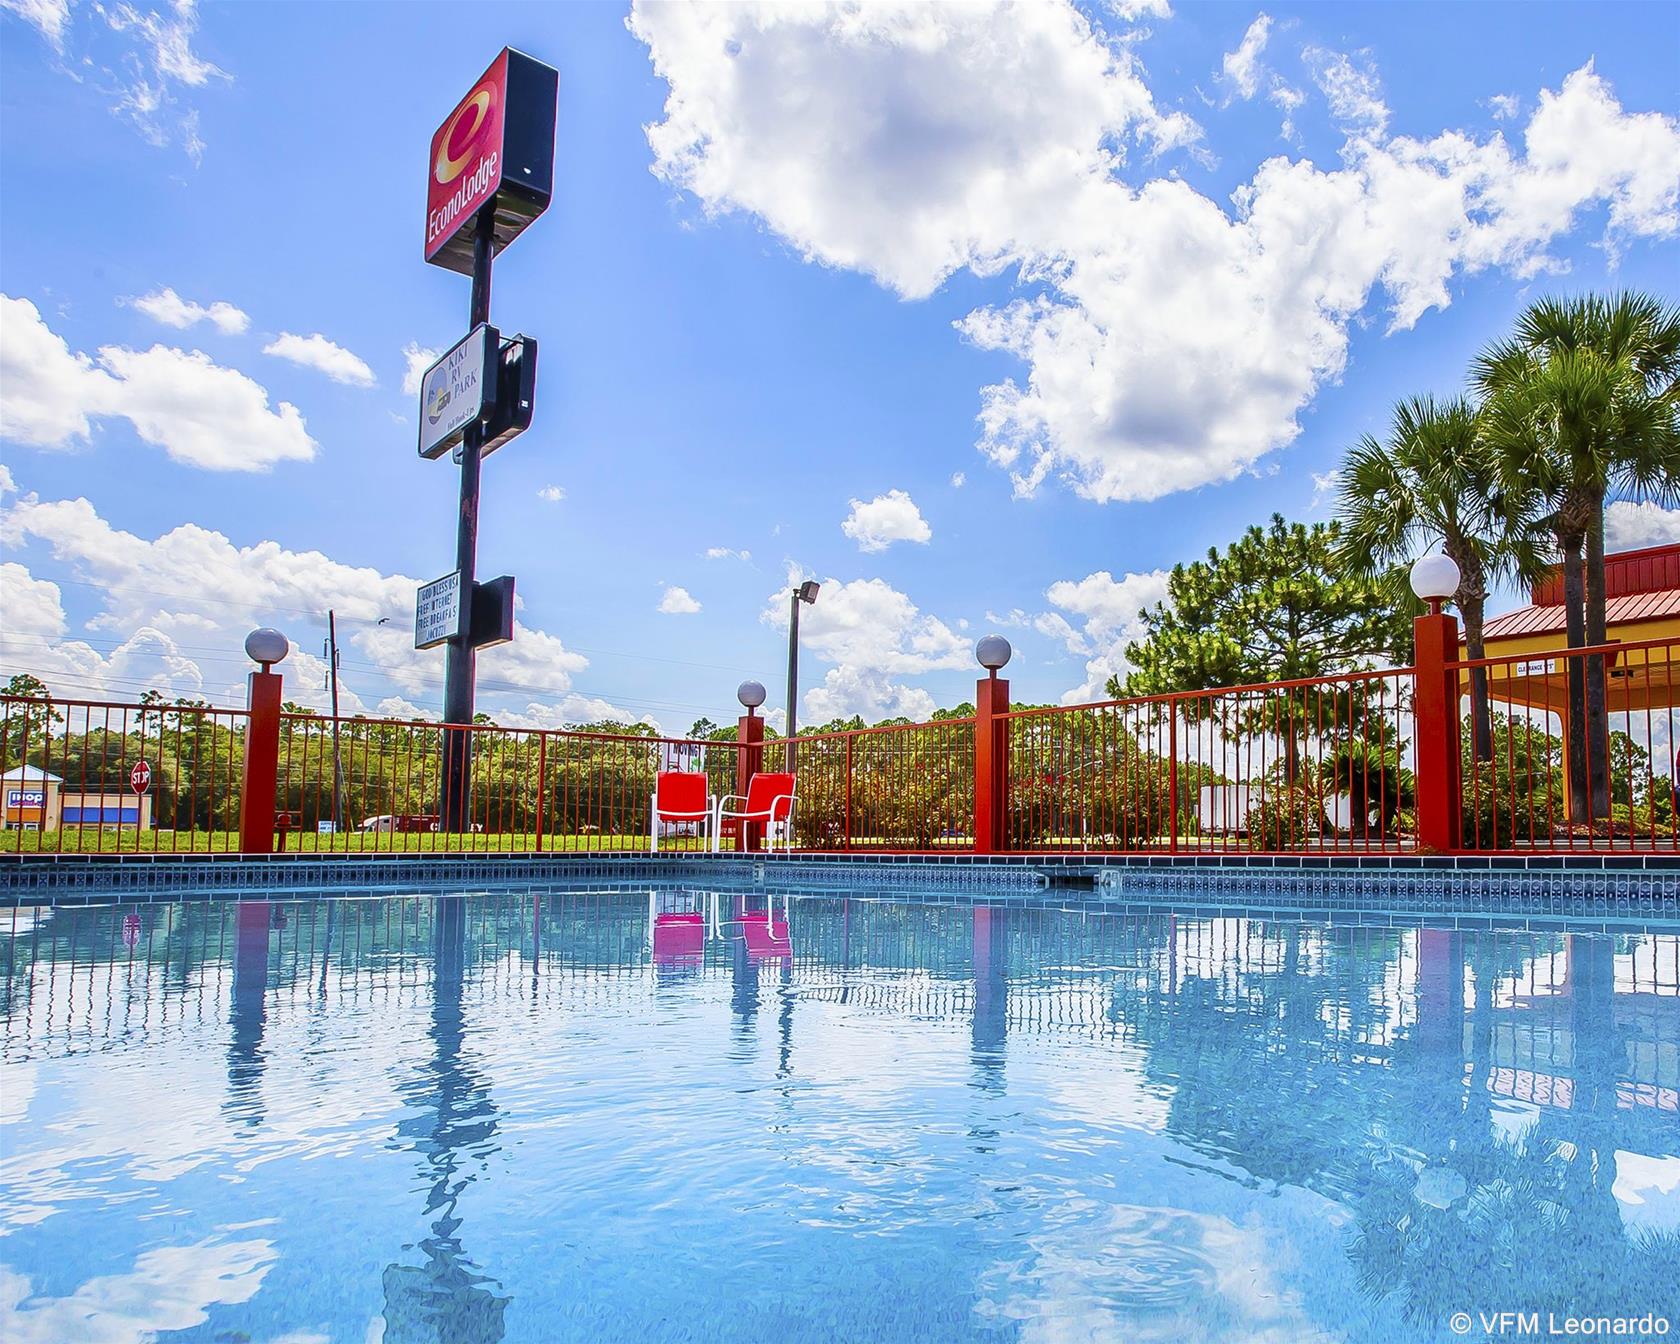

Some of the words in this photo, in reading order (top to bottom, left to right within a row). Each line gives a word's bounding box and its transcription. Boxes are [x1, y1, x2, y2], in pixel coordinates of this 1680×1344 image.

[448, 342, 468, 370] KIKI
[451, 363, 463, 385] RV
[454, 368, 478, 399] PARK
[422, 588, 432, 600] GOD
[433, 580, 448, 597] BLESS
